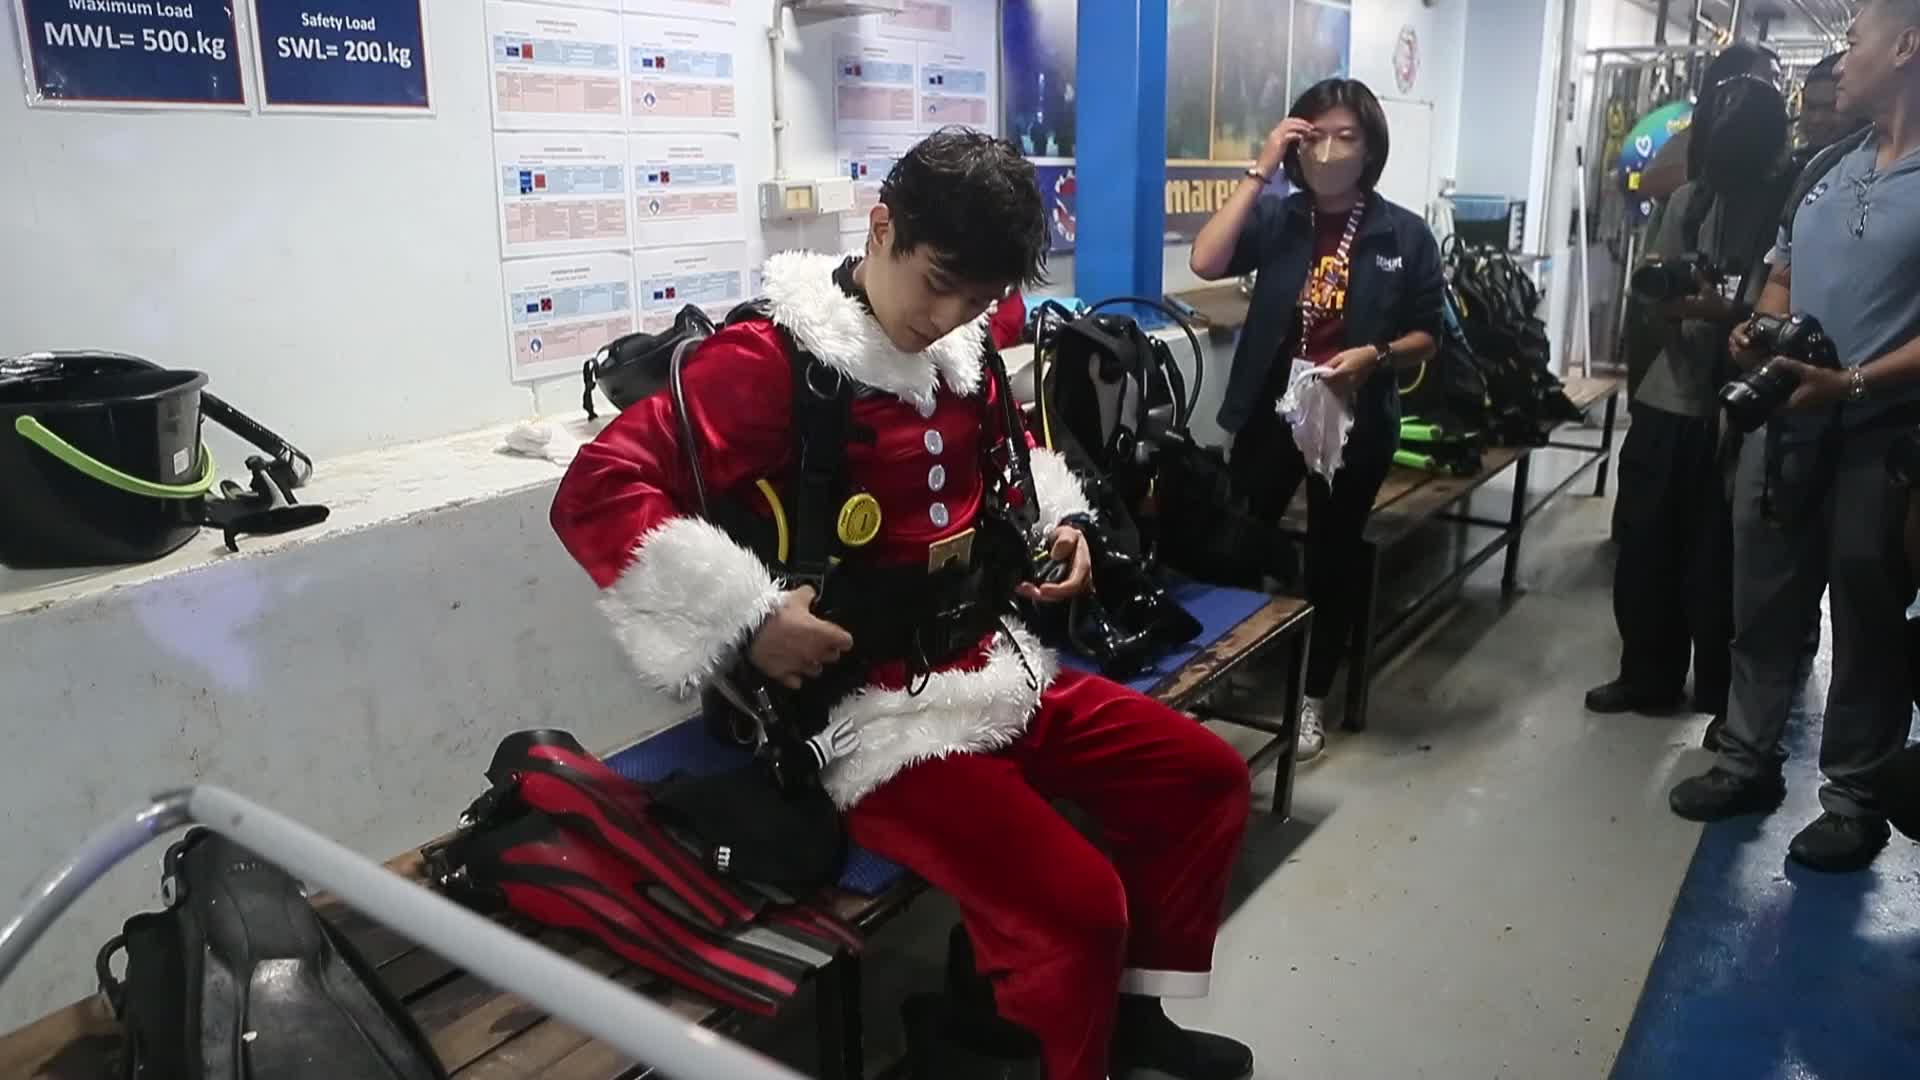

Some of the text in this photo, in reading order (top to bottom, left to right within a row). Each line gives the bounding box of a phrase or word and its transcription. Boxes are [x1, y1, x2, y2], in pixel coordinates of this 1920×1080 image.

[69, 0, 193, 18] Maximum Load
[301, 12, 376, 31] Safety Load
[44, 21, 227, 60] MWL= 500.kg
[277, 36, 412, 69] SWL= 200.kg
